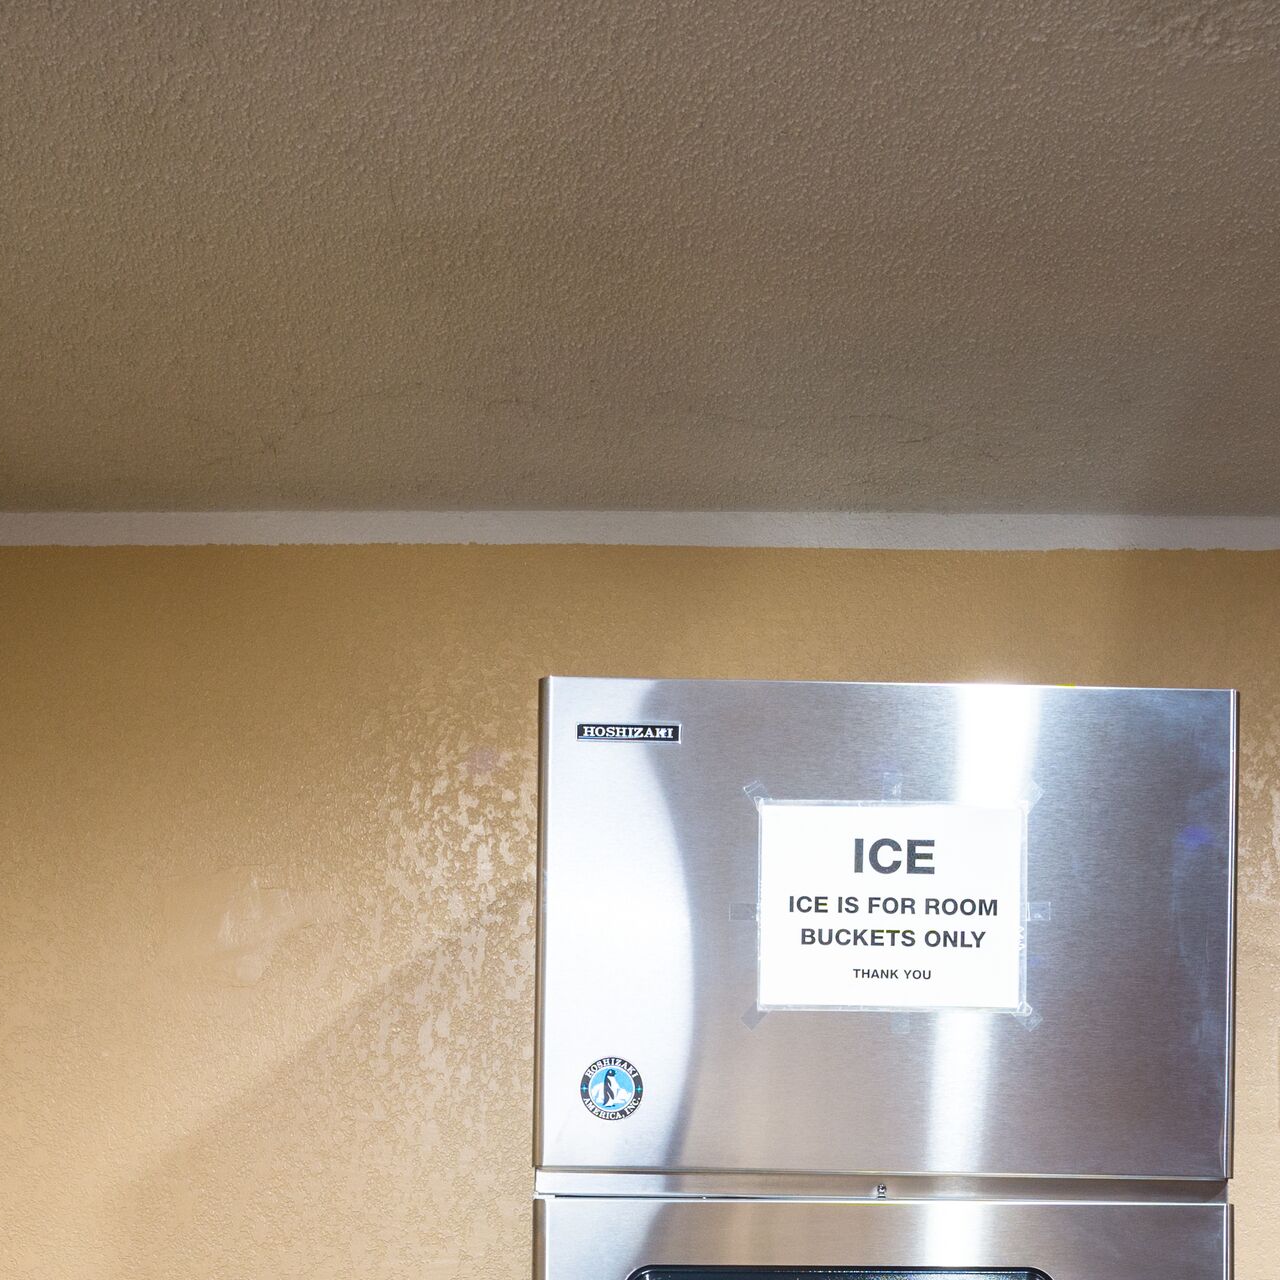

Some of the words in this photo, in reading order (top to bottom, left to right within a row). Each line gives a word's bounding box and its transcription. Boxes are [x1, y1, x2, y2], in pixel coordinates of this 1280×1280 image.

[583, 726, 674, 739] HOSHIZAKI
[854, 838, 935, 875] ICE
[789, 895, 829, 914] ICE
[837, 896, 860, 914] IS
[868, 897, 916, 915] FOR
[924, 898, 999, 917] ROOM
[801, 928, 916, 947] BUCKETS
[924, 930, 986, 949] ONLY
[852, 968, 899, 980] THANK
[903, 969, 932, 981] YOU
[585, 1058, 639, 1079] HOSHIZAKI
